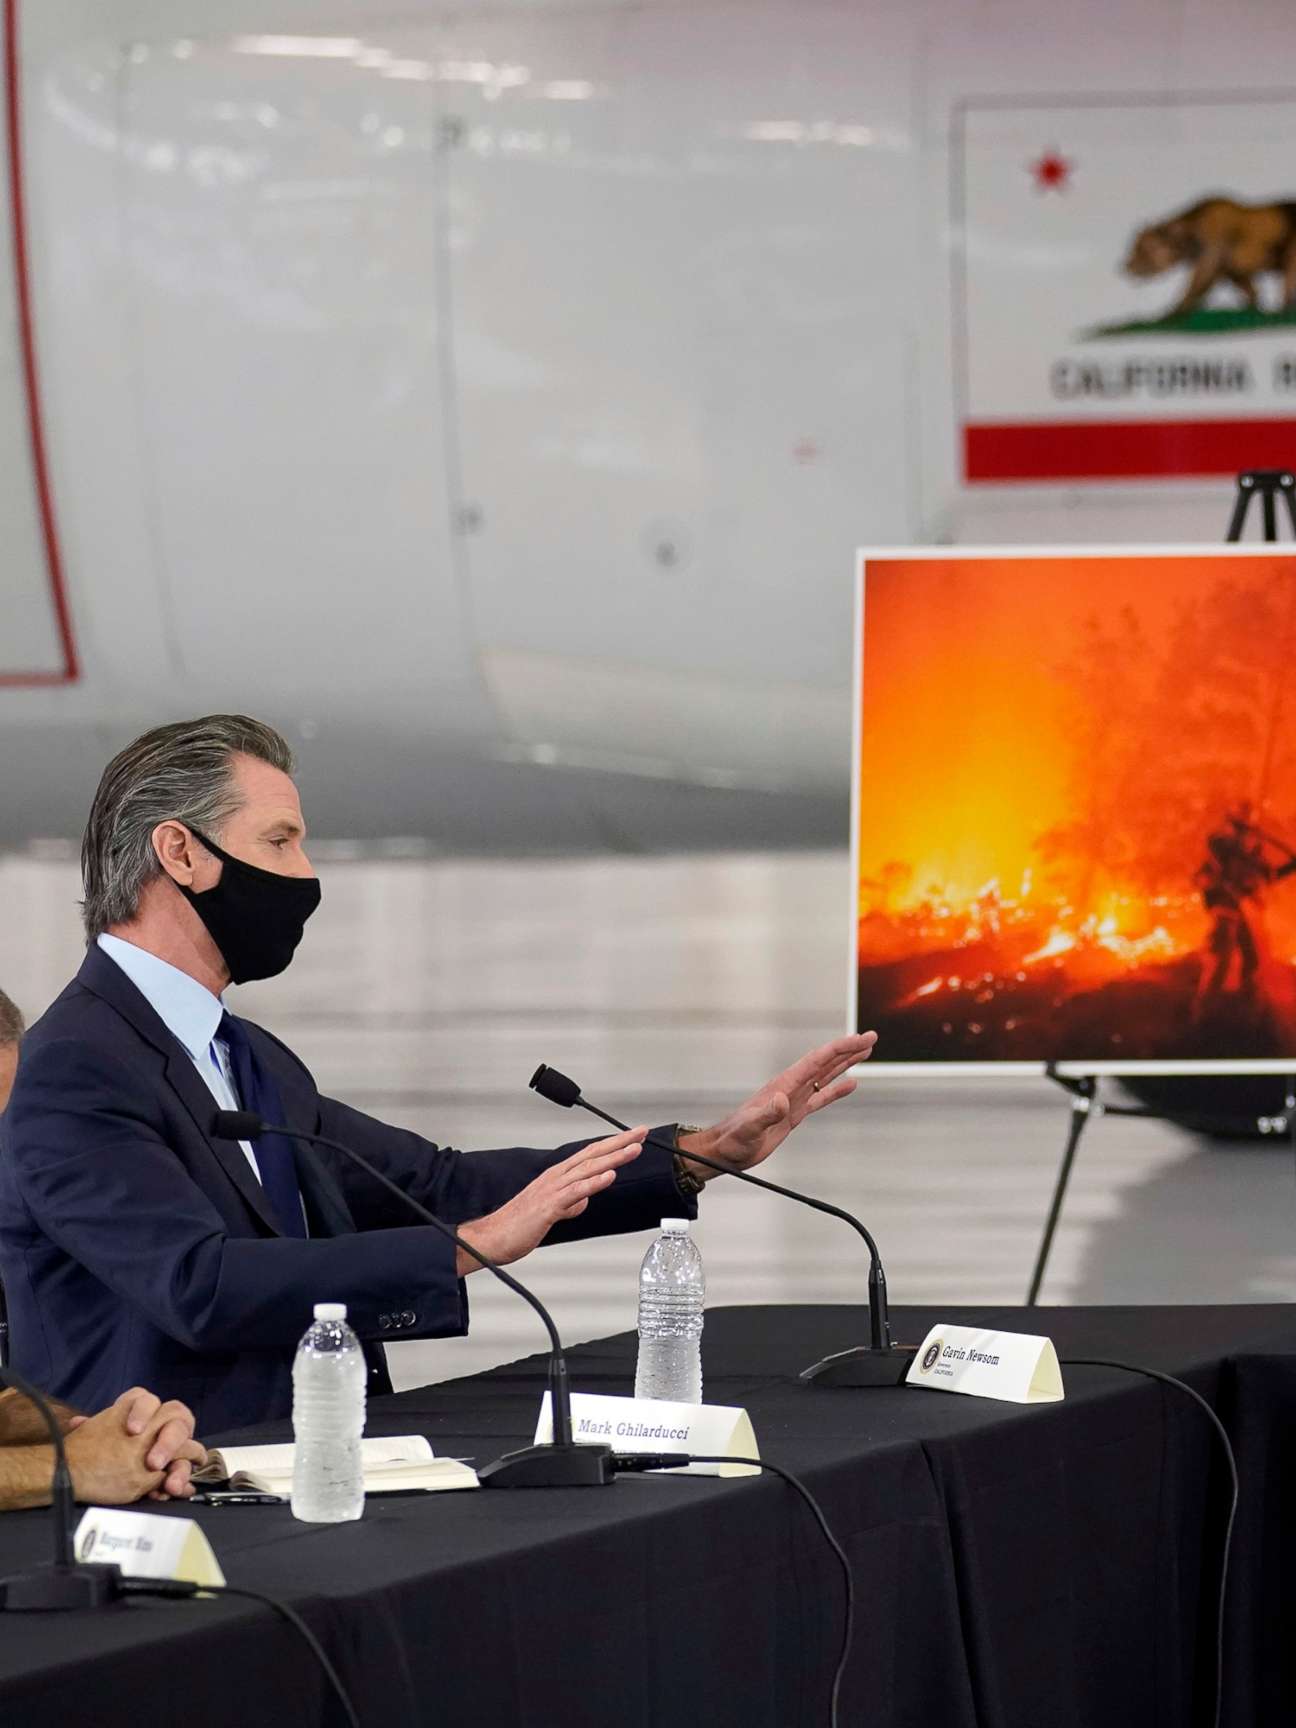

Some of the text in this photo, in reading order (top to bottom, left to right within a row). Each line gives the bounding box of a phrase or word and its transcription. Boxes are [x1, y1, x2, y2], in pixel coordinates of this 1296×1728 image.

[1051, 357, 1256, 398] CALIFORNIA
[942, 1345, 1000, 1366] Gavin Newsom
[577, 1419, 690, 1440] Mark Ghilarducci
